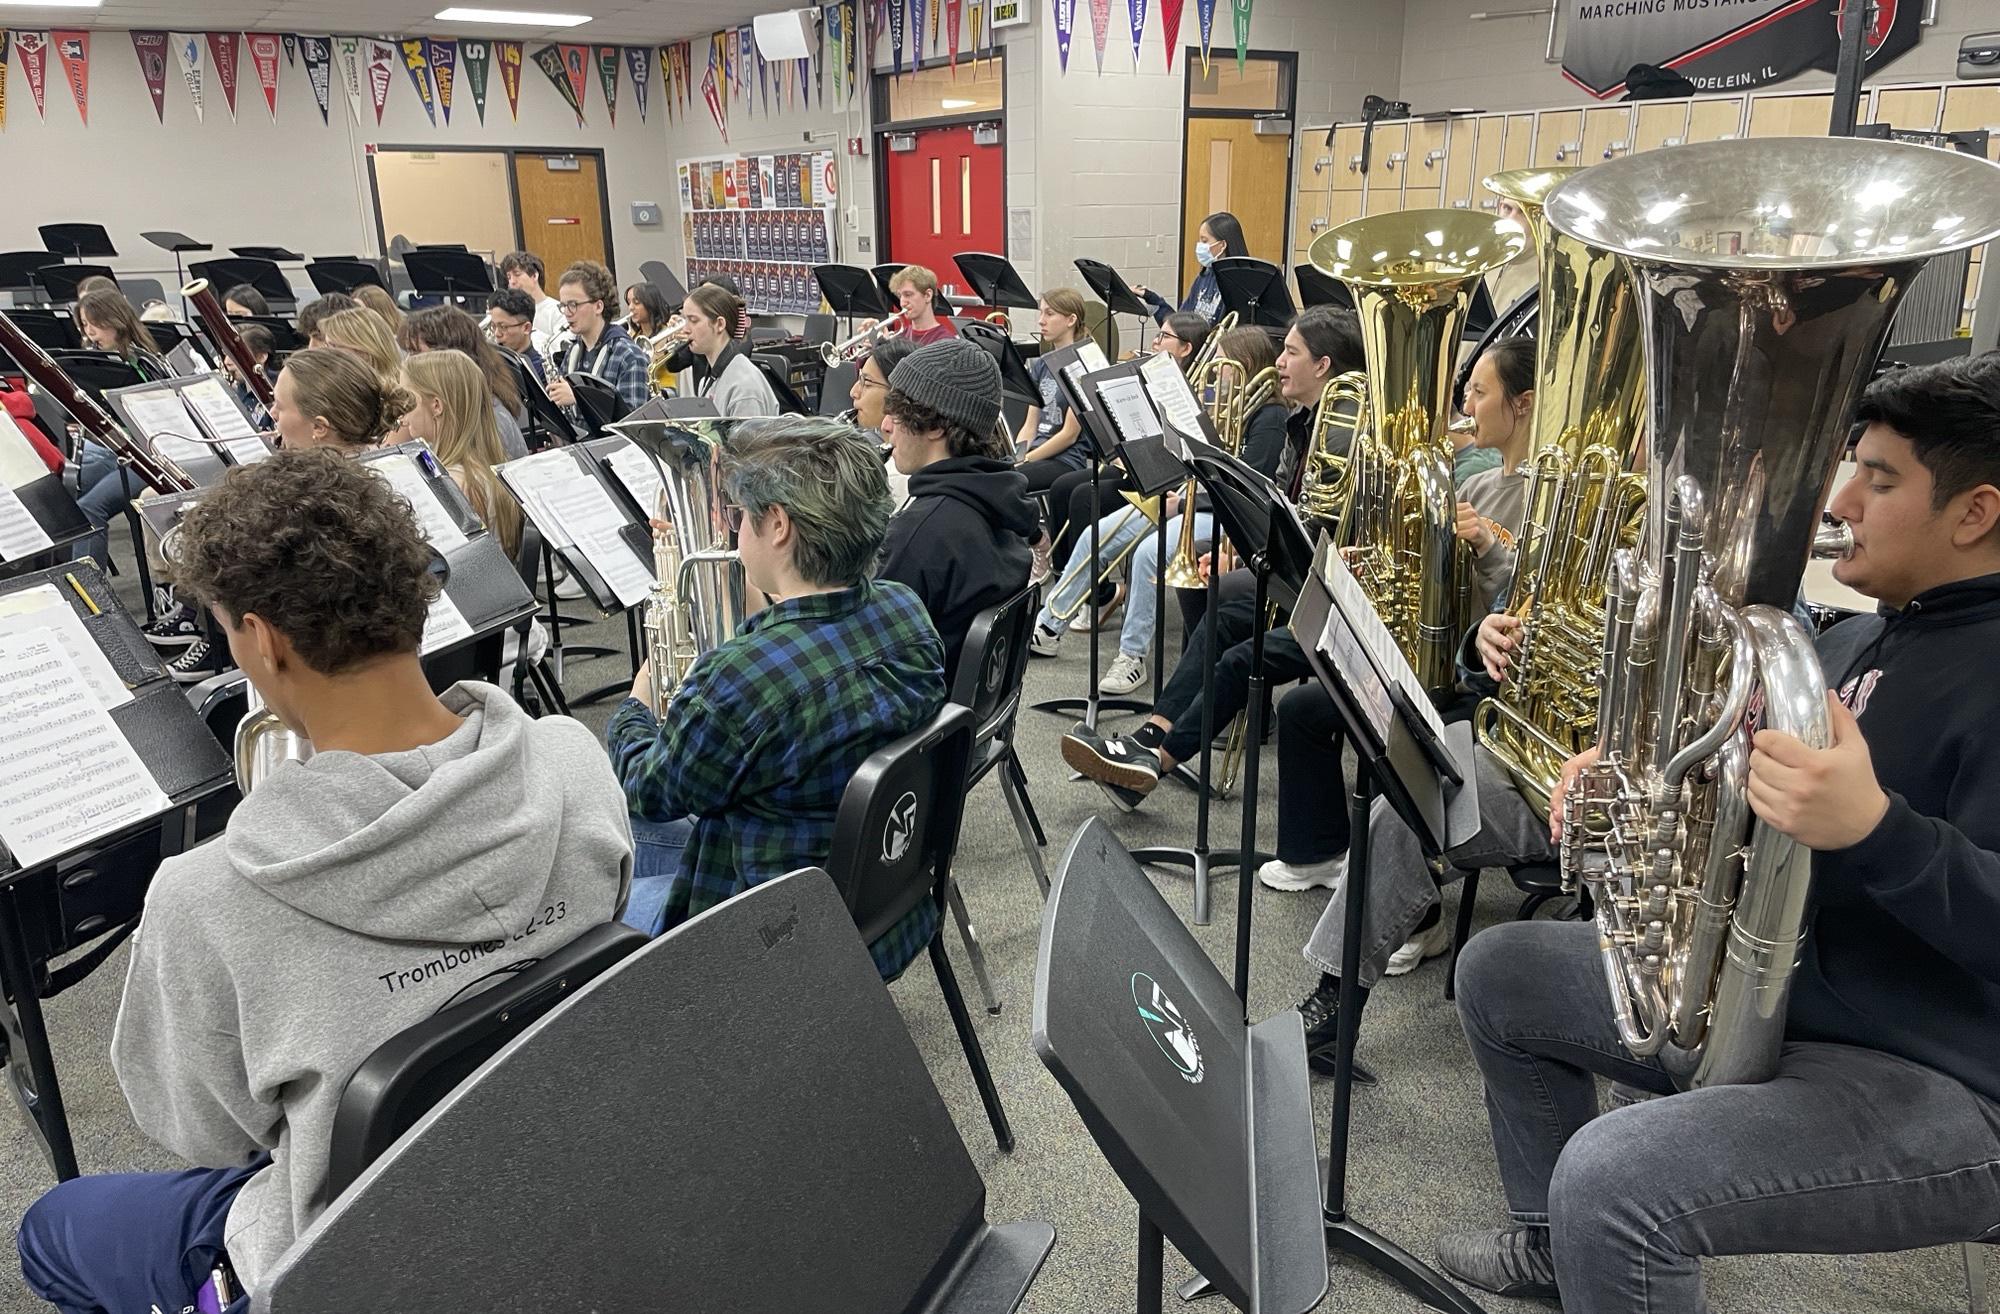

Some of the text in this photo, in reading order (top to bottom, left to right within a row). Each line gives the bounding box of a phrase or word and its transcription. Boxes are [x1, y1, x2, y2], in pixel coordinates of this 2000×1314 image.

[1579, 0, 1665, 19] MARCHING
[137, 35, 163, 46] SIU
[466, 44, 485, 59] S
[844, 6, 853, 65] California
[219, 45, 232, 88] CHICAGO
[402, 41, 427, 70] M
[431, 44, 452, 66] A
[632, 50, 646, 83] TCU
[72, 62, 86, 106] ILLINOIS
[344, 56, 354, 97] UNIVERSITY
[350, 56, 360, 96] ROOSEVELT
[441, 66, 452, 107] ALBION
[1681, 66, 1778, 89] NDELEIN, IL
